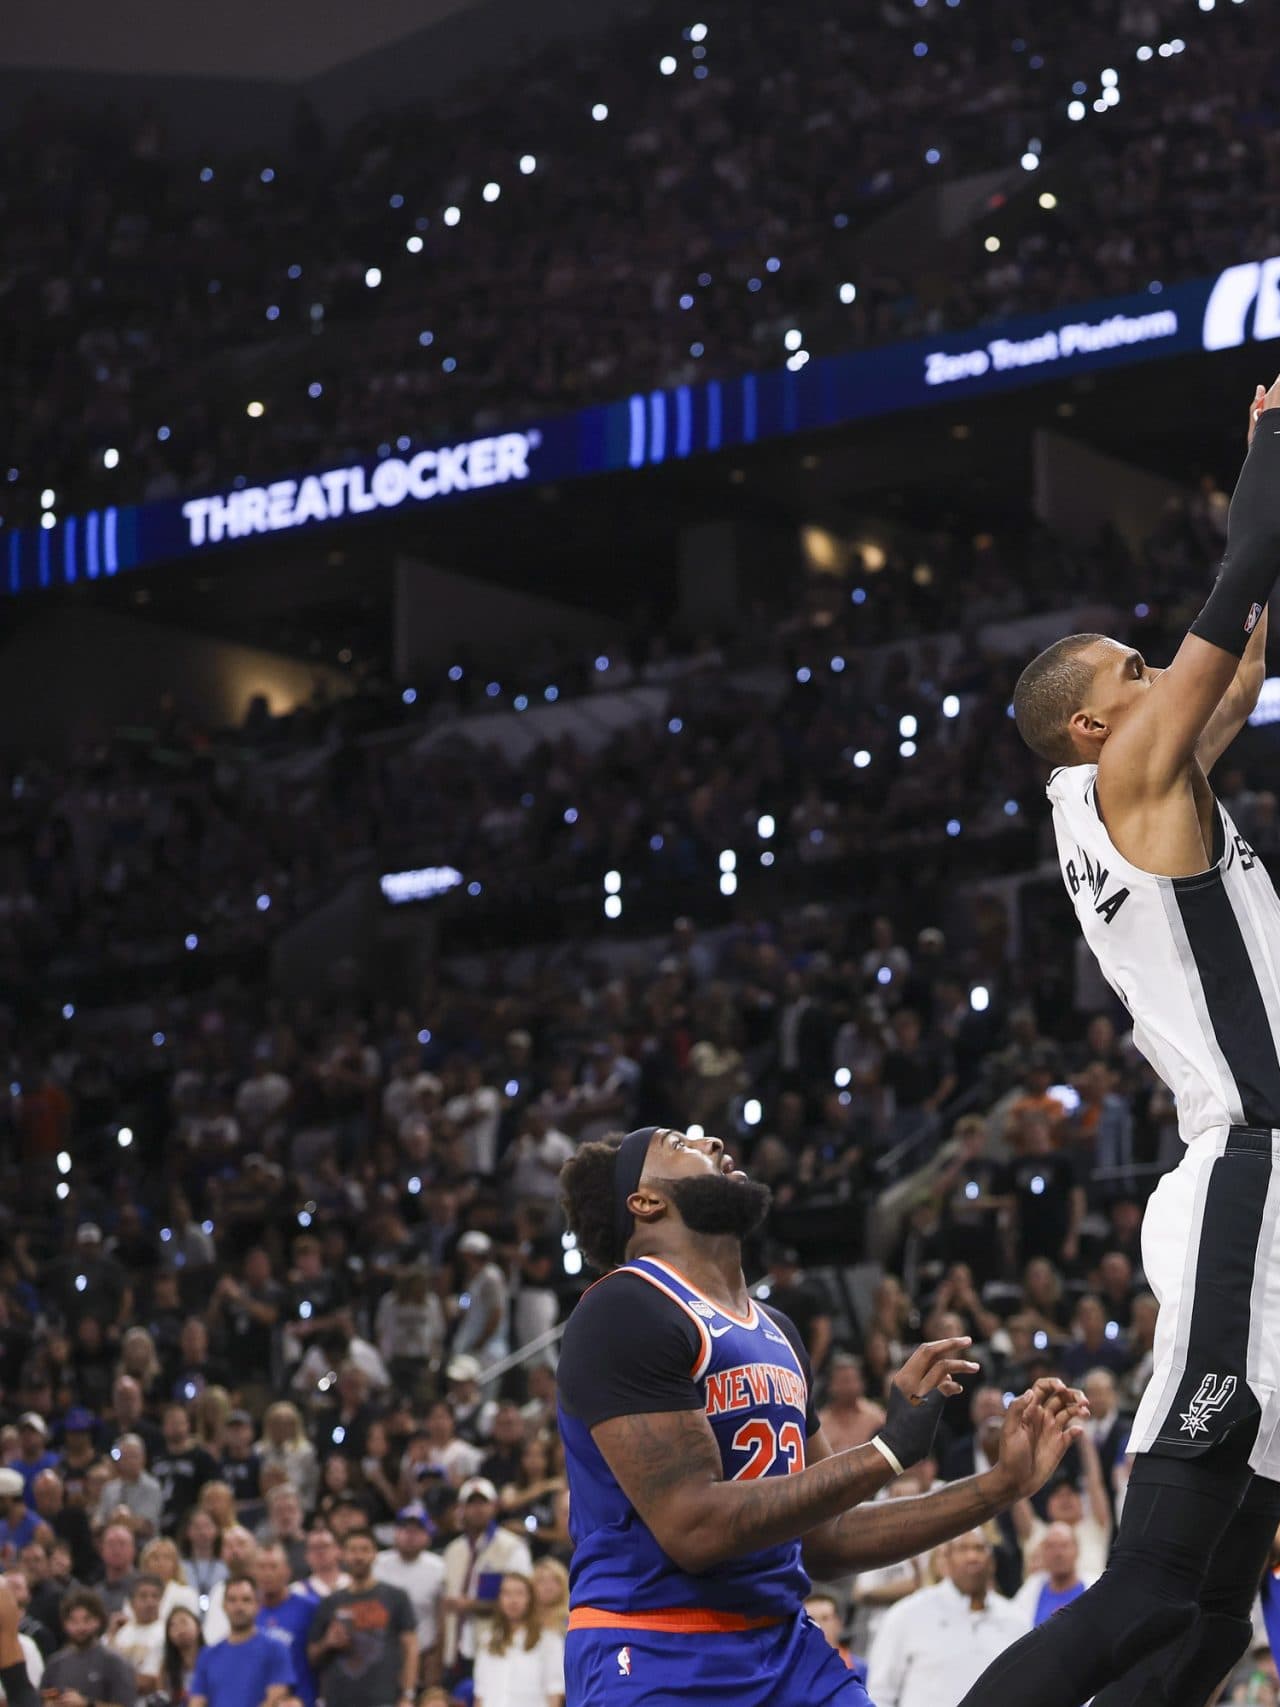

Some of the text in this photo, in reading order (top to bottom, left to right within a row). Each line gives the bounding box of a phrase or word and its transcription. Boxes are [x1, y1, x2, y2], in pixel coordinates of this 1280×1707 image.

[925, 310, 1178, 386] Zero Trust Platform
[182, 432, 531, 546] THREATLOCKER
